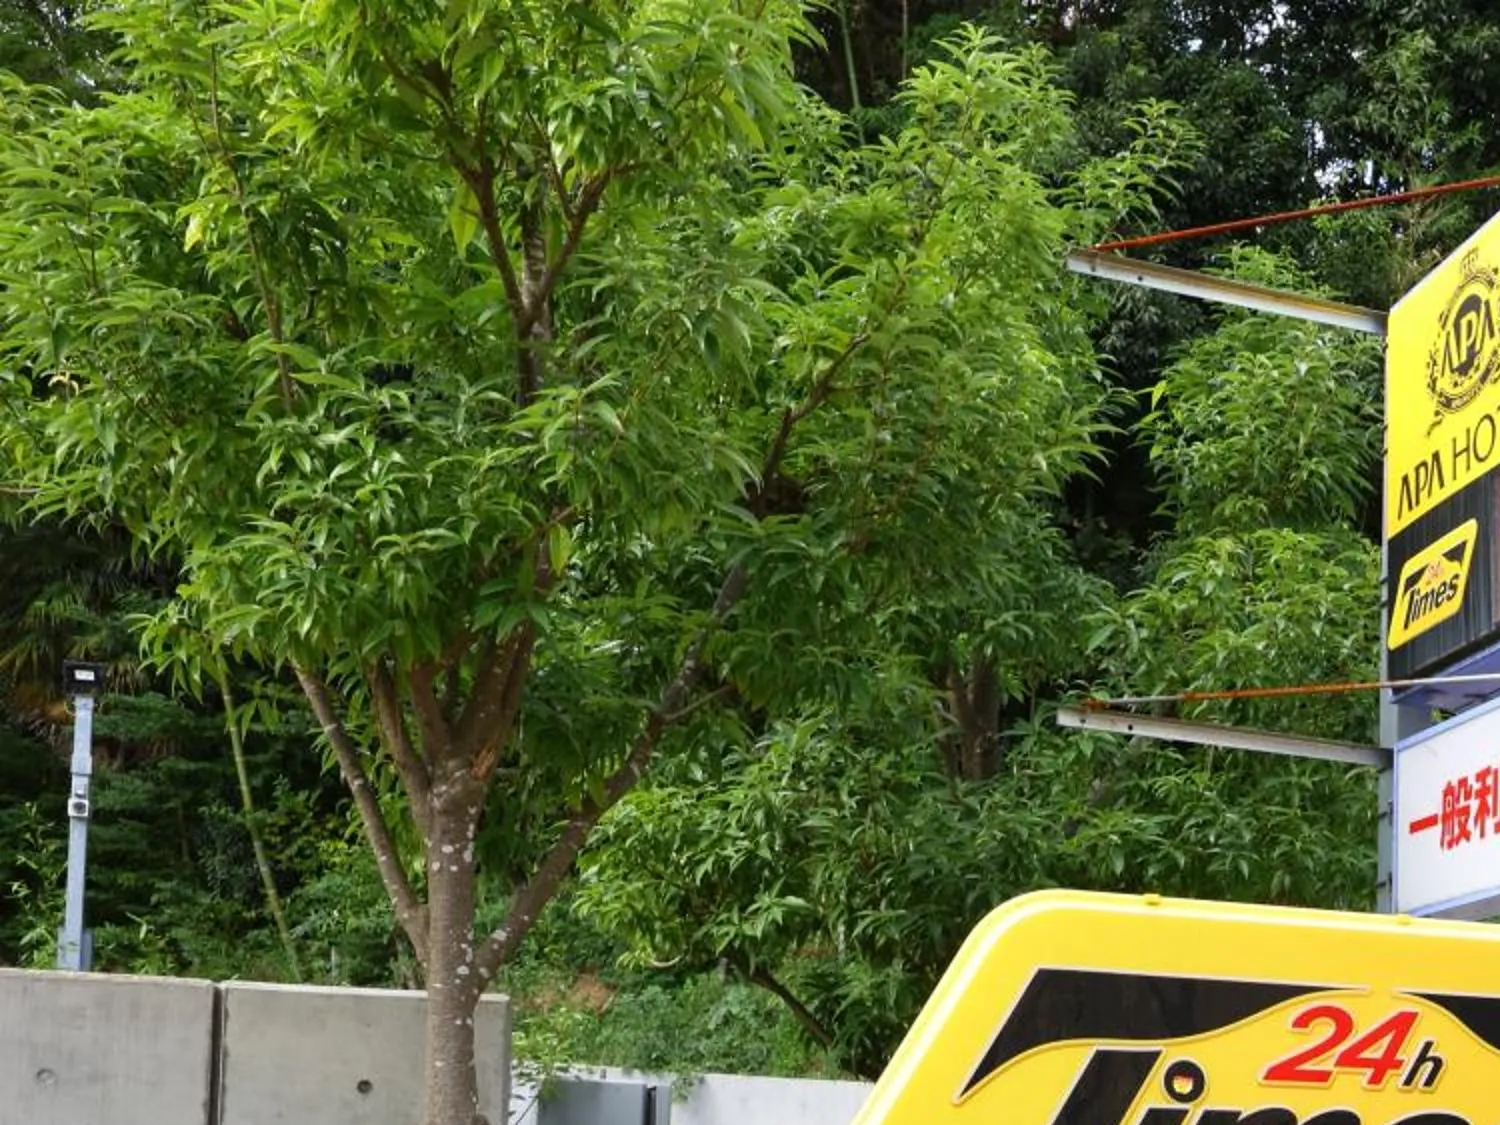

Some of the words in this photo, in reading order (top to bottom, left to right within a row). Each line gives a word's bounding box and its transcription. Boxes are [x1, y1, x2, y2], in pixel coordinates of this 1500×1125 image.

[1397, 451, 1445, 522] APA
[1403, 572, 1460, 629] Times
[1260, 1005, 1445, 1092] 24h
